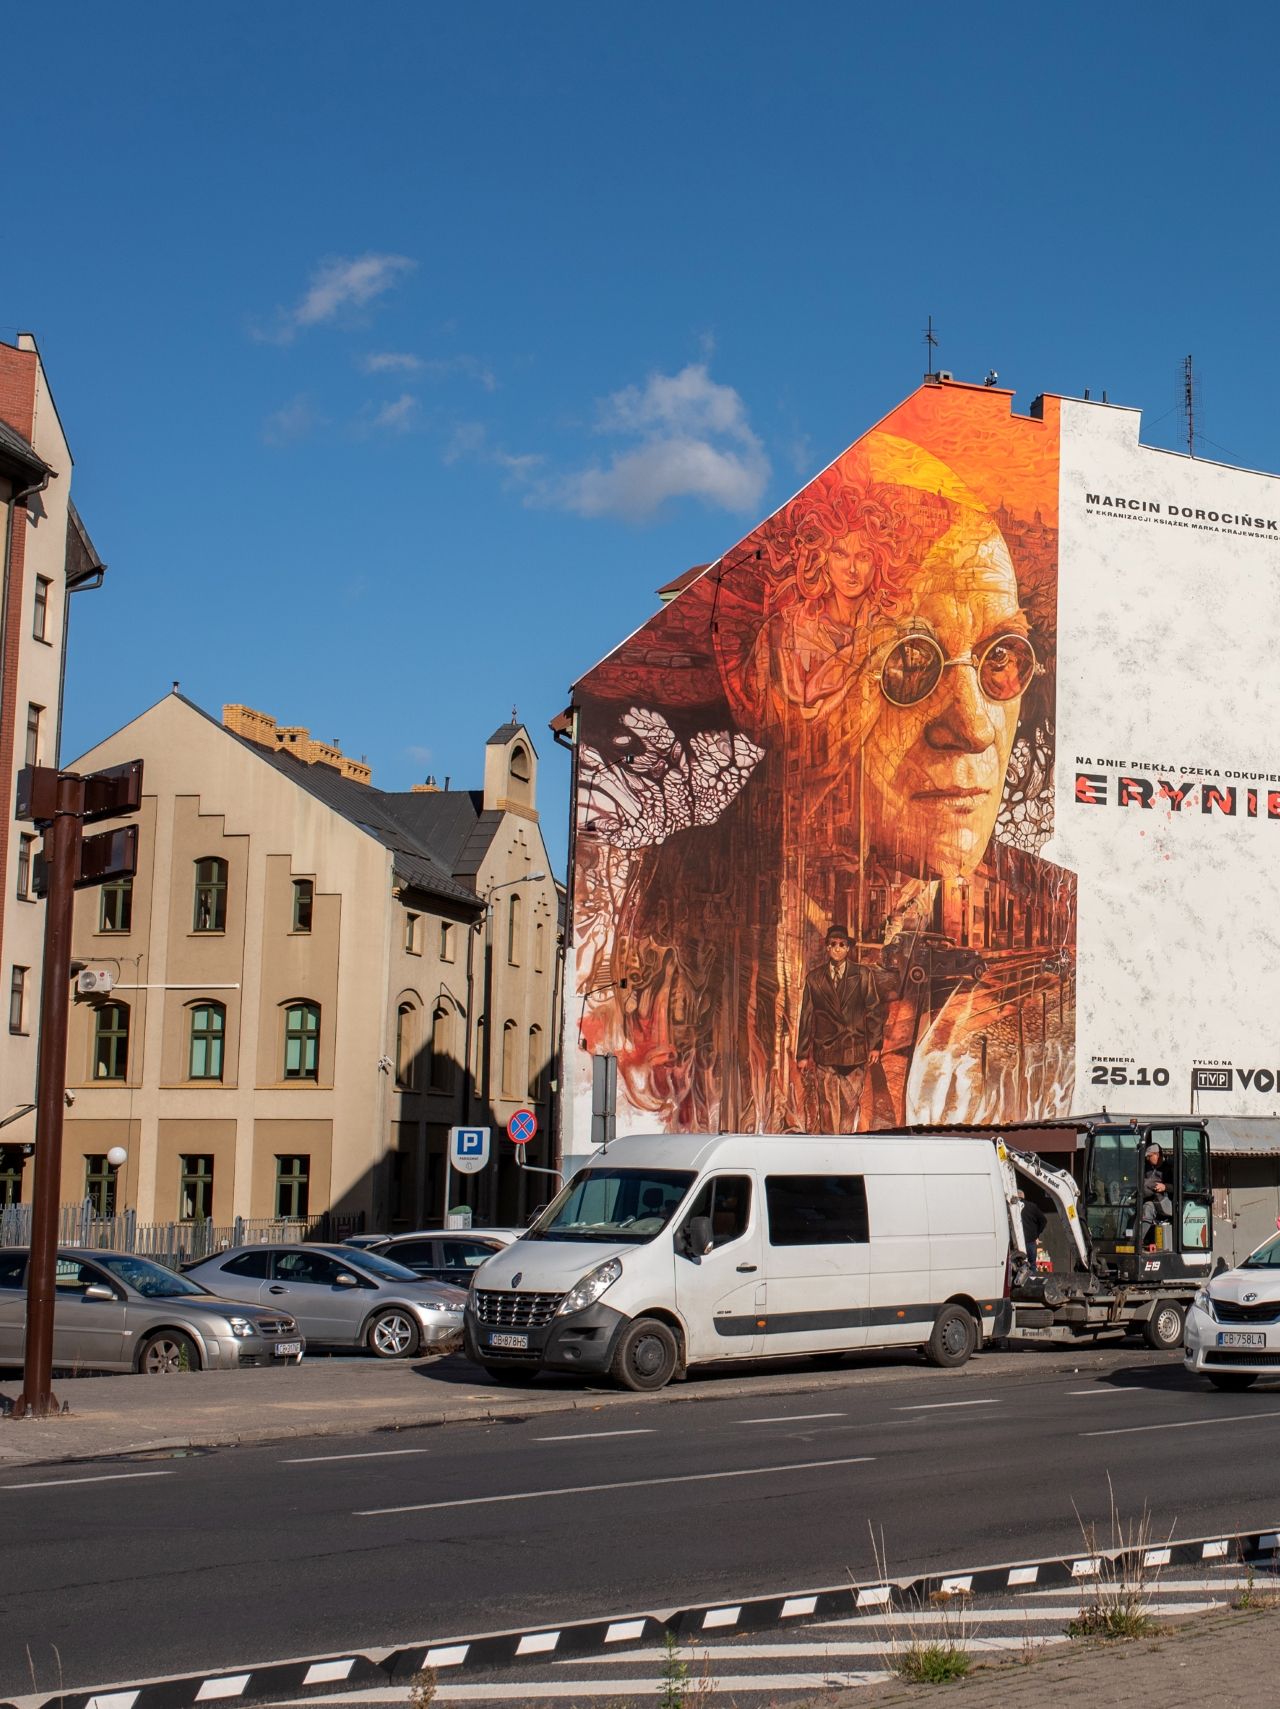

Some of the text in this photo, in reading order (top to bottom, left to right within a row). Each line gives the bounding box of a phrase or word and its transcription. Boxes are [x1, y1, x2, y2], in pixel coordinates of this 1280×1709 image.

[1086, 493, 1160, 513] MARCIN
[1096, 510, 1151, 522] EKRANIZACJI
[1154, 518, 1189, 528] KSIĄŻEK
[1191, 523, 1220, 532] MARKA
[1075, 756, 1092, 765] NA
[1097, 758, 1127, 768] DNIE
[1131, 761, 1176, 773] PIEKŁA
[1180, 766, 1220, 777] CZEKA
[1091, 1065, 1170, 1087] 25.10
[1199, 1072, 1227, 1086] TVP
[463, 1133, 478, 1152] P
